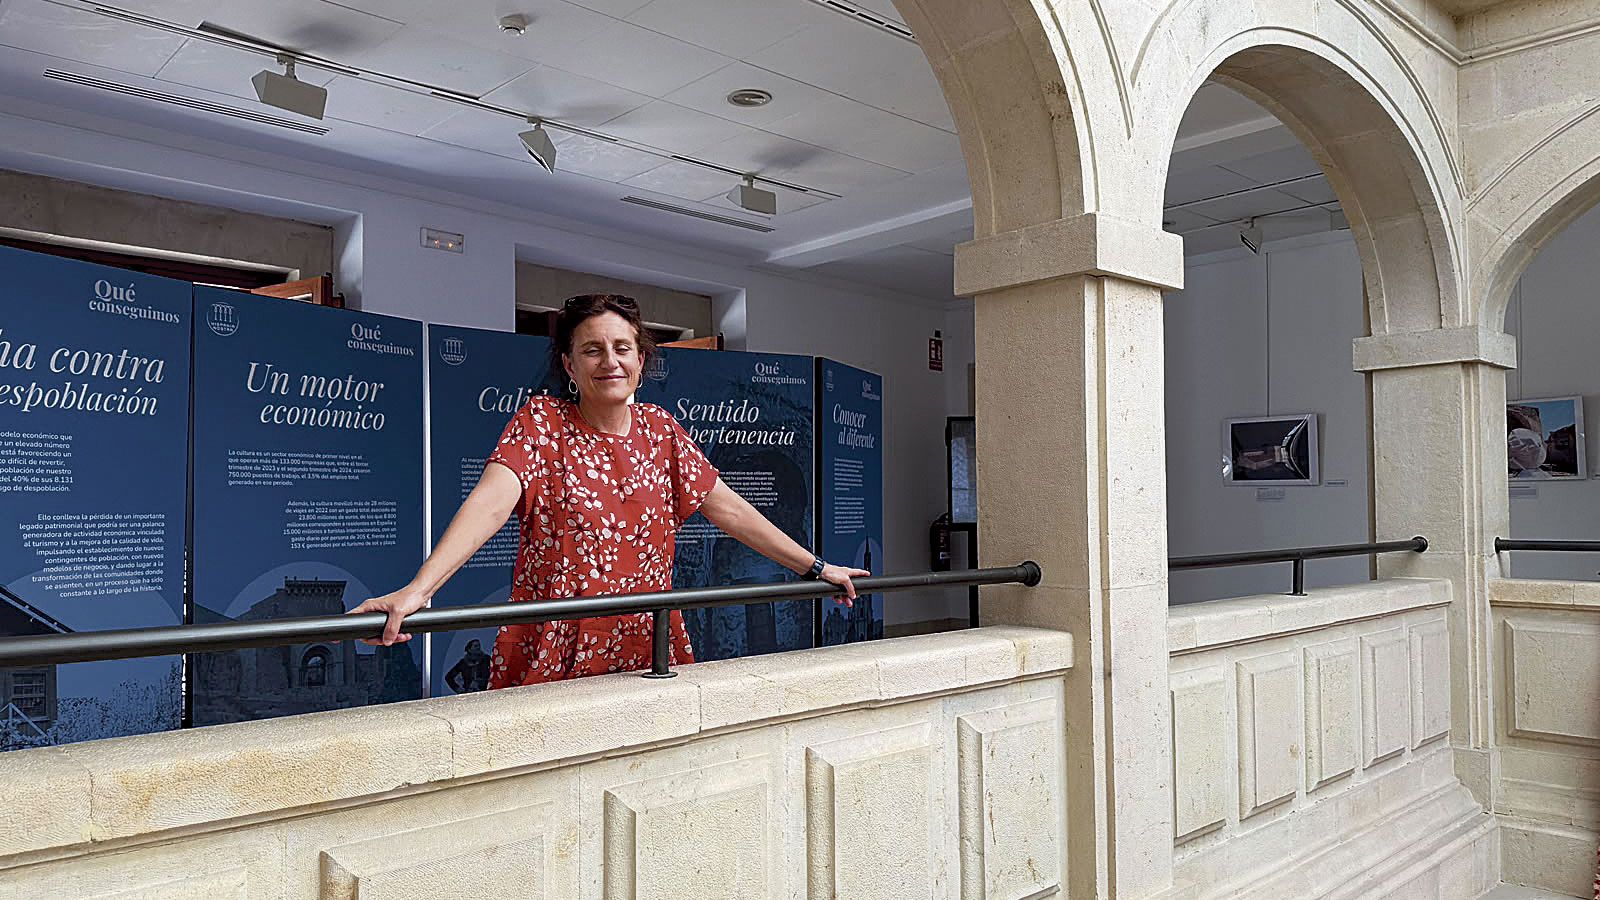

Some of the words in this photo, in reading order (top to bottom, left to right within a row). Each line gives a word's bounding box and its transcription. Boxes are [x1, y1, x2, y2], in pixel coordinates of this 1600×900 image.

[94, 279, 136, 302] Qué
[88, 299, 180, 324] conseguimos
[350, 322, 382, 341] Qué
[347, 339, 415, 357] conseguimos
[50, 347, 165, 383] contra
[755, 362, 780, 376] Qué
[247, 362, 290, 395] Un
[300, 374, 385, 403] motor
[752, 375, 807, 385] conseguimos
[478, 386, 548, 414] Cali
[260, 400, 385, 431] económico
[674, 397, 760, 424] Sentido
[834, 403, 866, 428] Conocer
[16, 440, 42, 448] elevado
[22, 432, 59, 440] económico
[846, 428, 875, 450] diferente
[18, 448, 62, 457] favoreciendo
[22, 532, 62, 540] generadora
[36, 548, 76, 556] impulsando
[32, 574, 82, 582] transformación
[104, 570, 144, 578] comunidades
